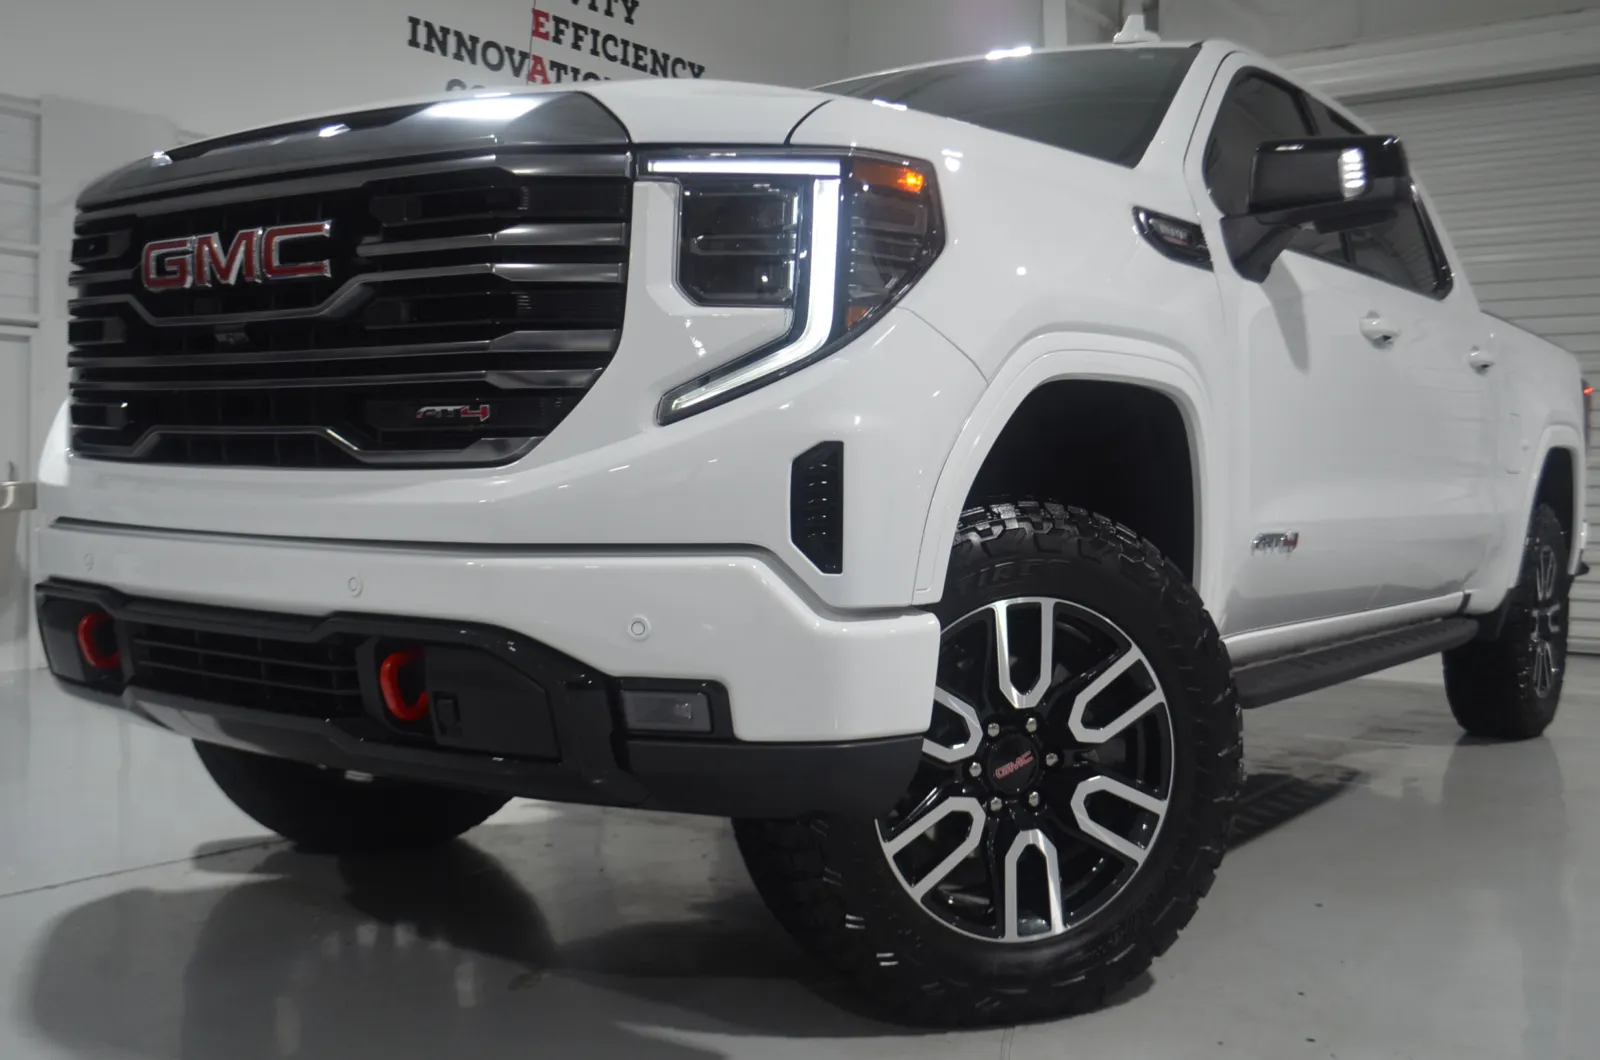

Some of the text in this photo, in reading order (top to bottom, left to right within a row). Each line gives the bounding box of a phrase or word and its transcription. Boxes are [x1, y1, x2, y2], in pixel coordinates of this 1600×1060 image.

[408, 16, 612, 85] INNOVATI
[532, 8, 706, 79] EFFICIENCY
[141, 220, 332, 292] GMC
[995, 750, 1034, 779] GMC
